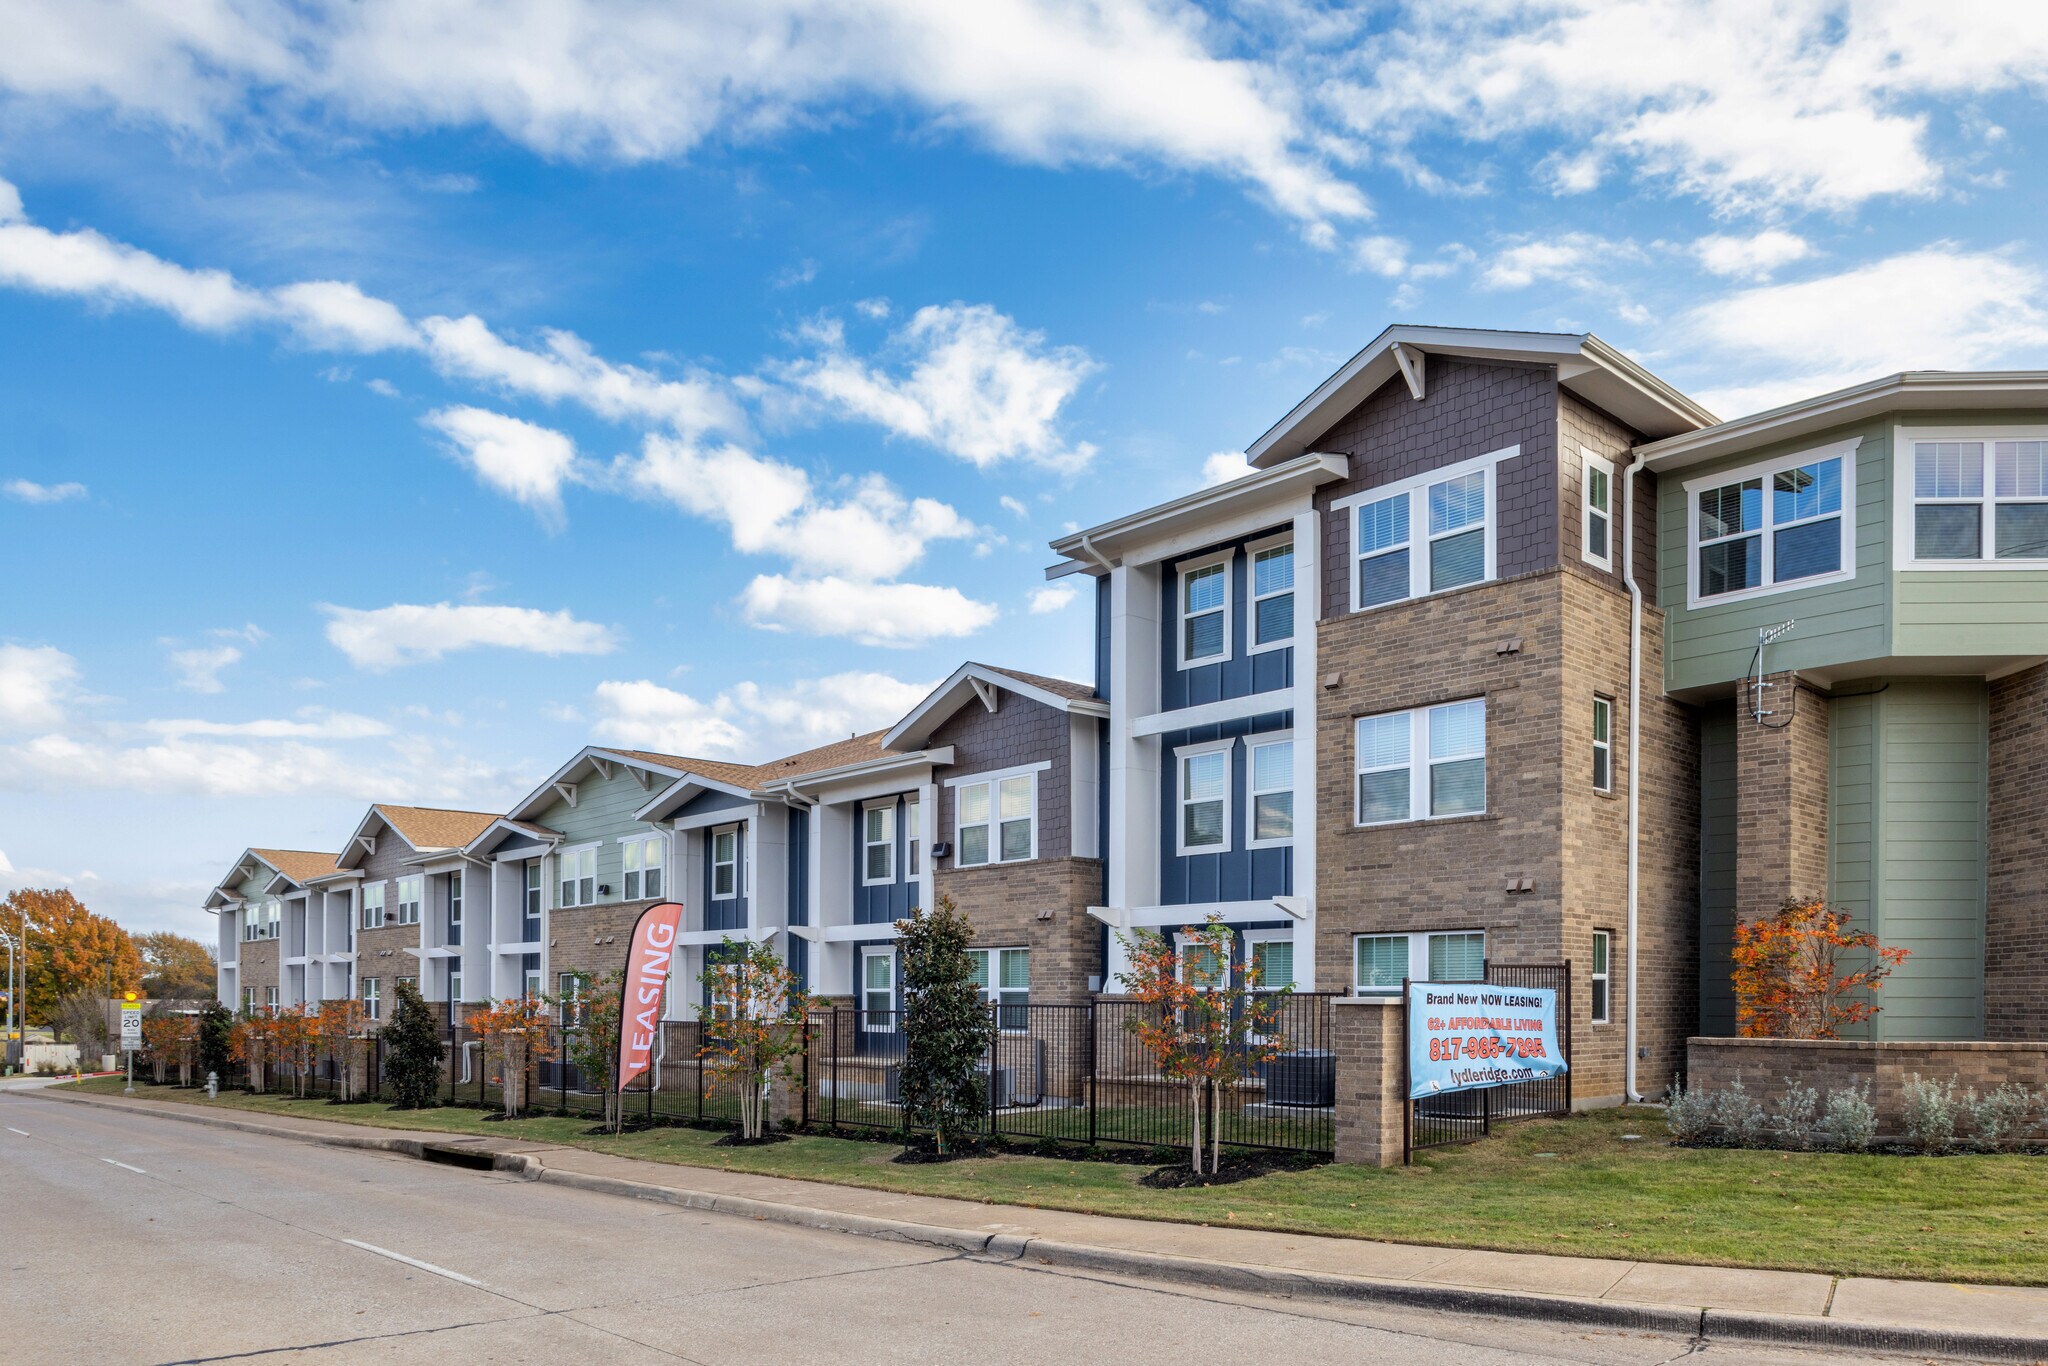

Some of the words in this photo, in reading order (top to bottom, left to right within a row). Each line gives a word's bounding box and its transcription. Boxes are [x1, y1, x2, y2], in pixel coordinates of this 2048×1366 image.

[629, 922, 675, 1069] LEASING
[1426, 993, 1454, 1005] Brand
[1457, 993, 1478, 1005] New
[1481, 994, 1502, 1006] NOW
[1504, 995, 1543, 1008] LEASING!
[123, 1019, 140, 1028] 20
[1427, 1017, 1446, 1031] 62+
[1448, 1017, 1512, 1031] AFFORDABLE
[1513, 1018, 1543, 1032] LIVING
[1429, 1037, 1547, 1061] 817-985-7895
[1450, 1067, 1534, 1087] lydleridge.com
